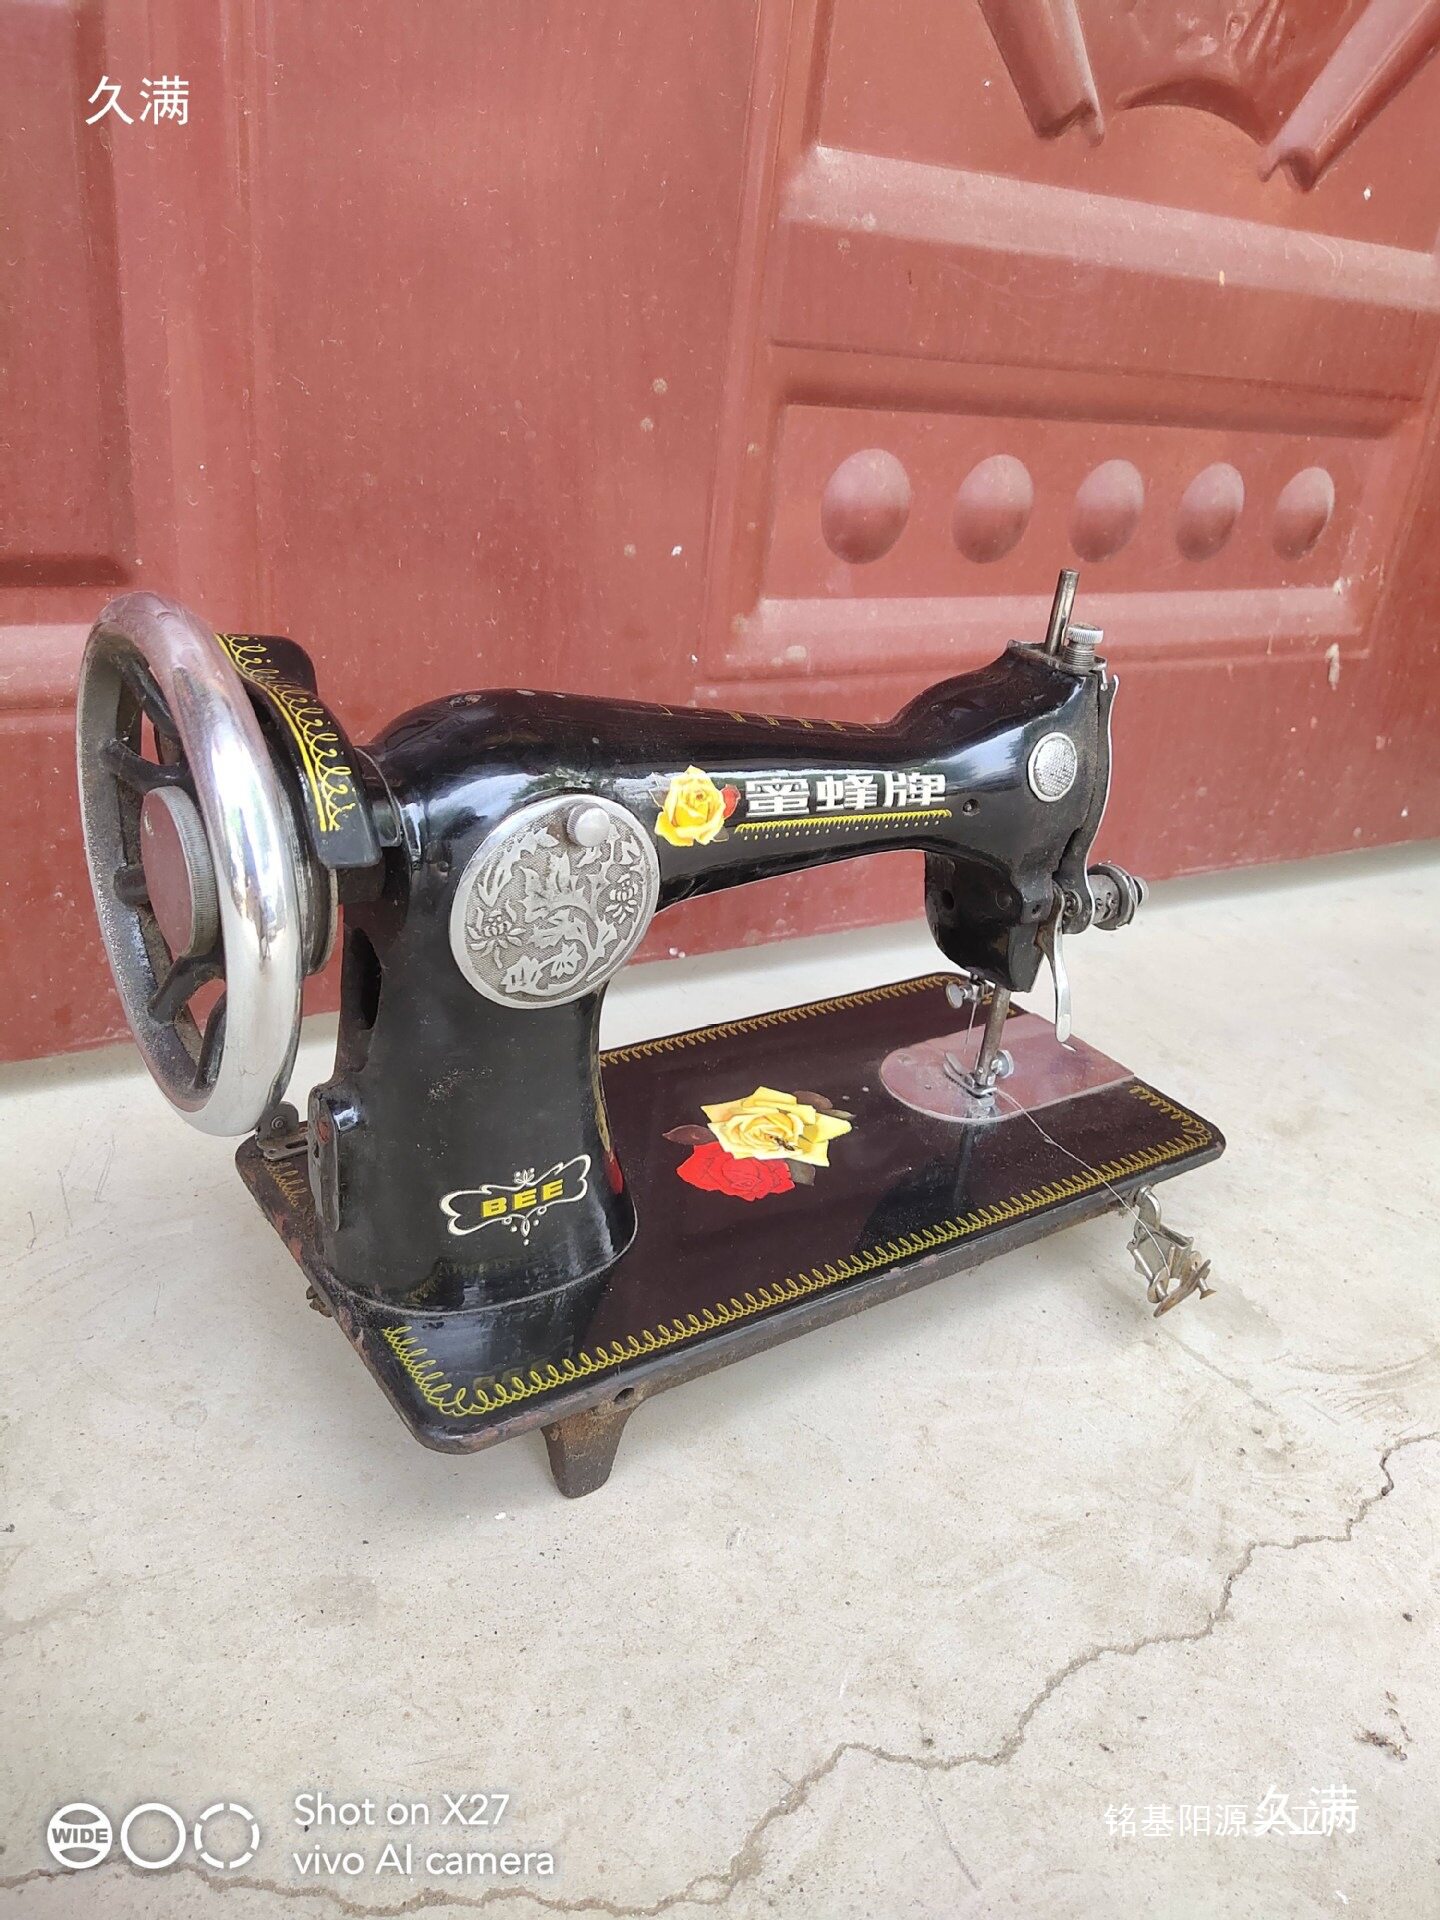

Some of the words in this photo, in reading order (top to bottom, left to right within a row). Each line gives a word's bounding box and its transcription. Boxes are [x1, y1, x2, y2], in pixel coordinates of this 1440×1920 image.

[745, 771, 946, 818] 蜜蜂牌
[481, 1178, 564, 1218] BEE
